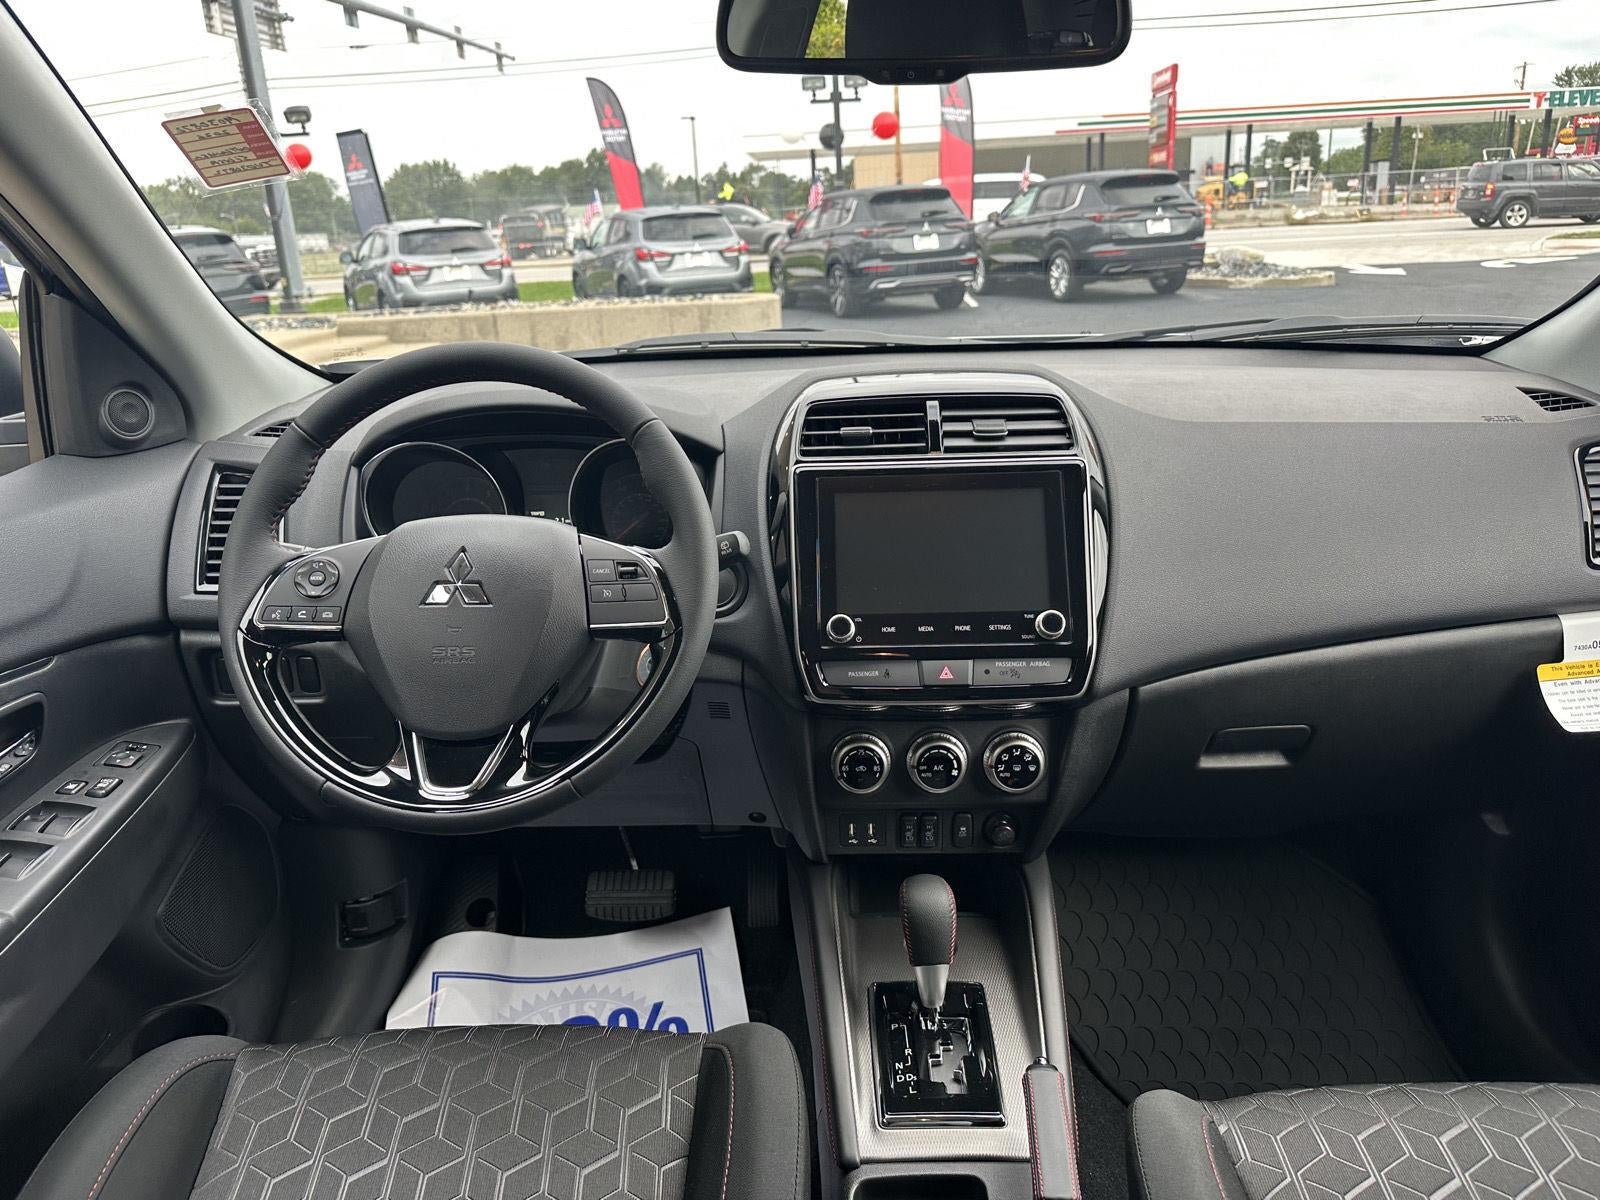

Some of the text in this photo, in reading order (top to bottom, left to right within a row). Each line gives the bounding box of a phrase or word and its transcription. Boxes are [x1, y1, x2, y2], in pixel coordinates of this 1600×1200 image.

[431, 646, 476, 657] SRS
[891, 1023, 899, 1031] P
[904, 1048, 912, 1056] R
[895, 1062, 904, 1070] N
[909, 1086, 918, 1094] L
